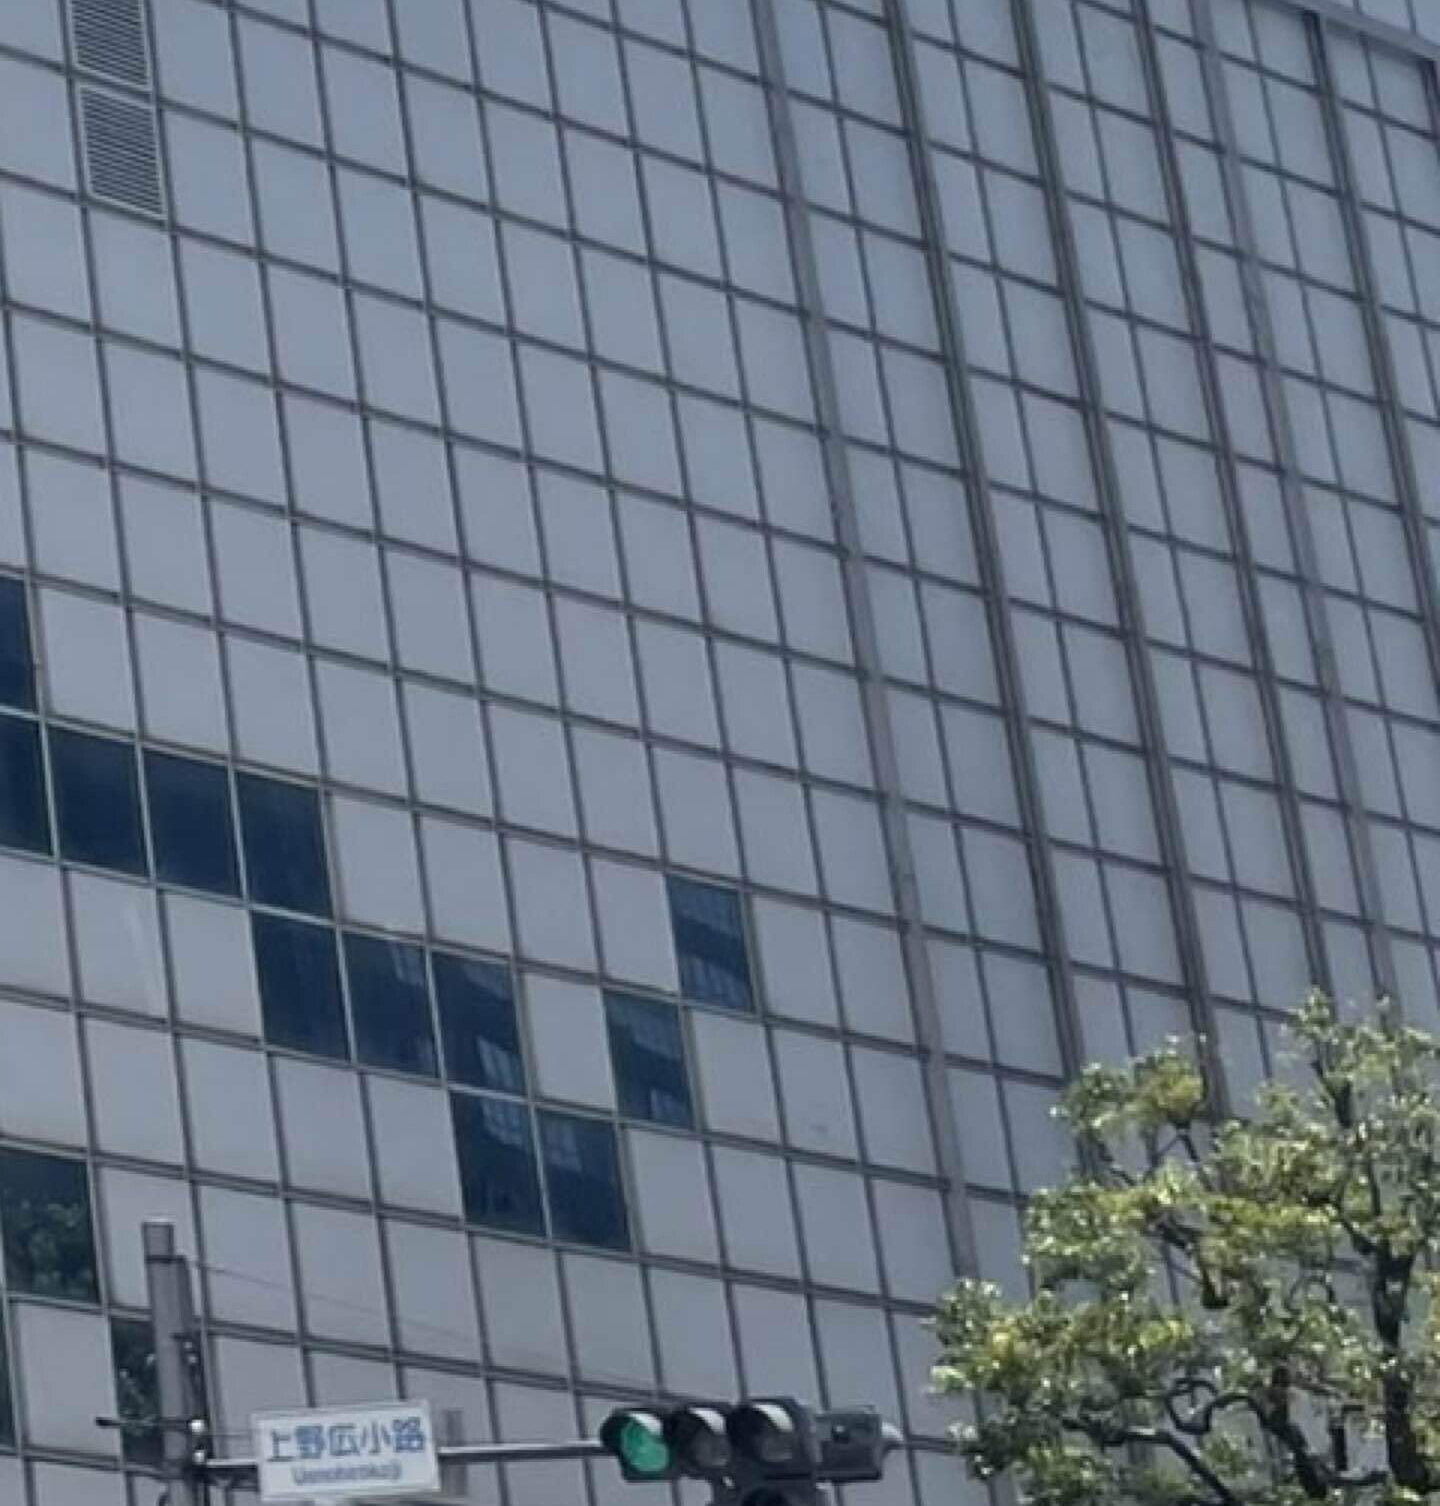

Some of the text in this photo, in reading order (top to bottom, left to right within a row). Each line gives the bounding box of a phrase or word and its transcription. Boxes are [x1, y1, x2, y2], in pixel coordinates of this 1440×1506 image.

[266, 1415, 425, 1463] 上野広小路
